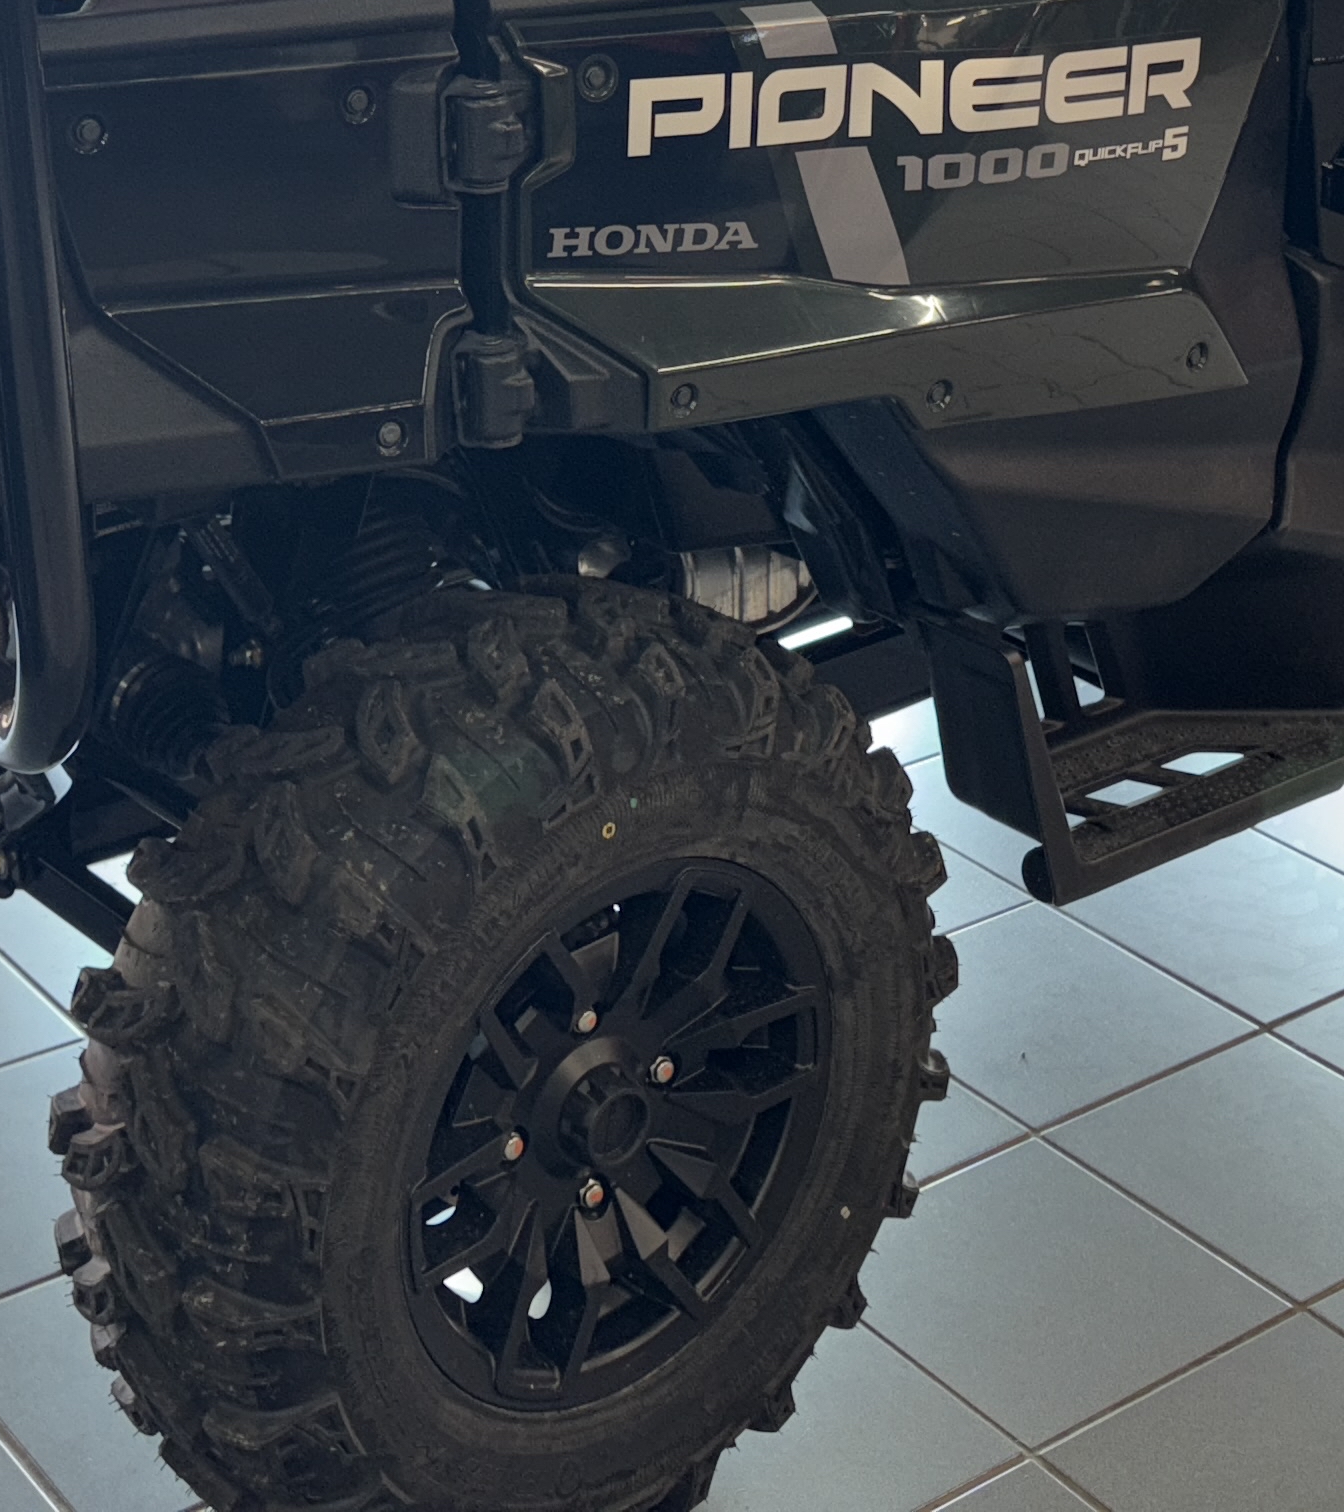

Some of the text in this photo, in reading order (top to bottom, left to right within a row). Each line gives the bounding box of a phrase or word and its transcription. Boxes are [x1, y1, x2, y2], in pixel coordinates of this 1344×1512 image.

[626, 37, 1202, 158] PIONEER
[895, 142, 1071, 192] 1000
[546, 221, 759, 259] HONDA
